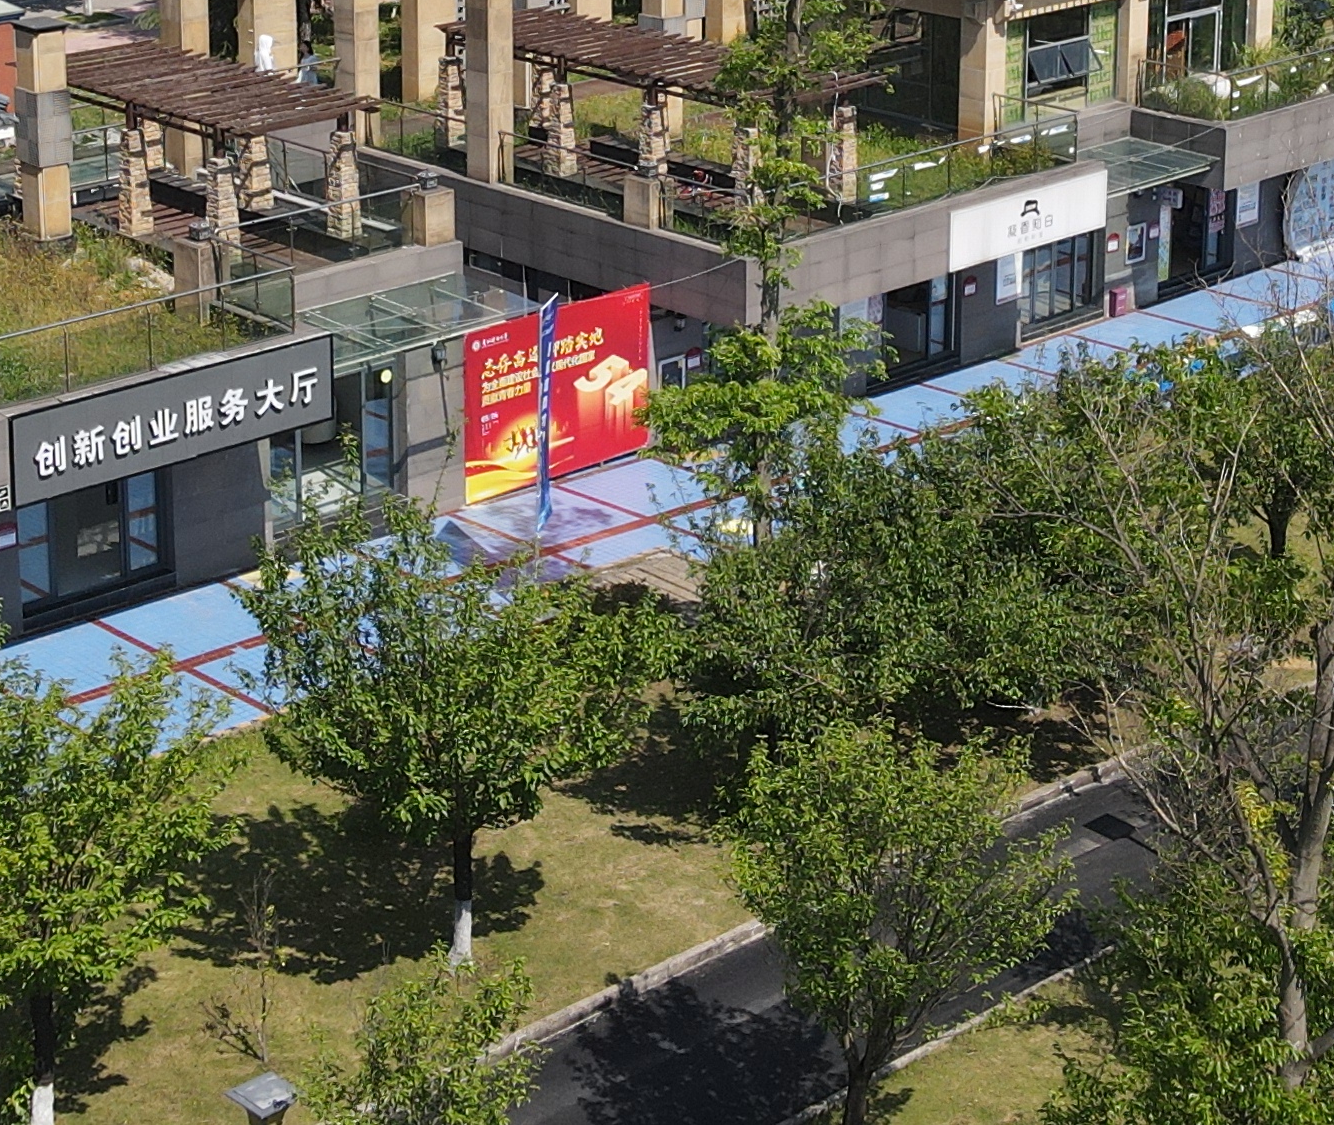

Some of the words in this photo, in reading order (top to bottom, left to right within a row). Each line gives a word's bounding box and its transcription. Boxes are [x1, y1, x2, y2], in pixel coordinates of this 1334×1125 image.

[35, 367, 318, 477] 创新创业服务大厅
